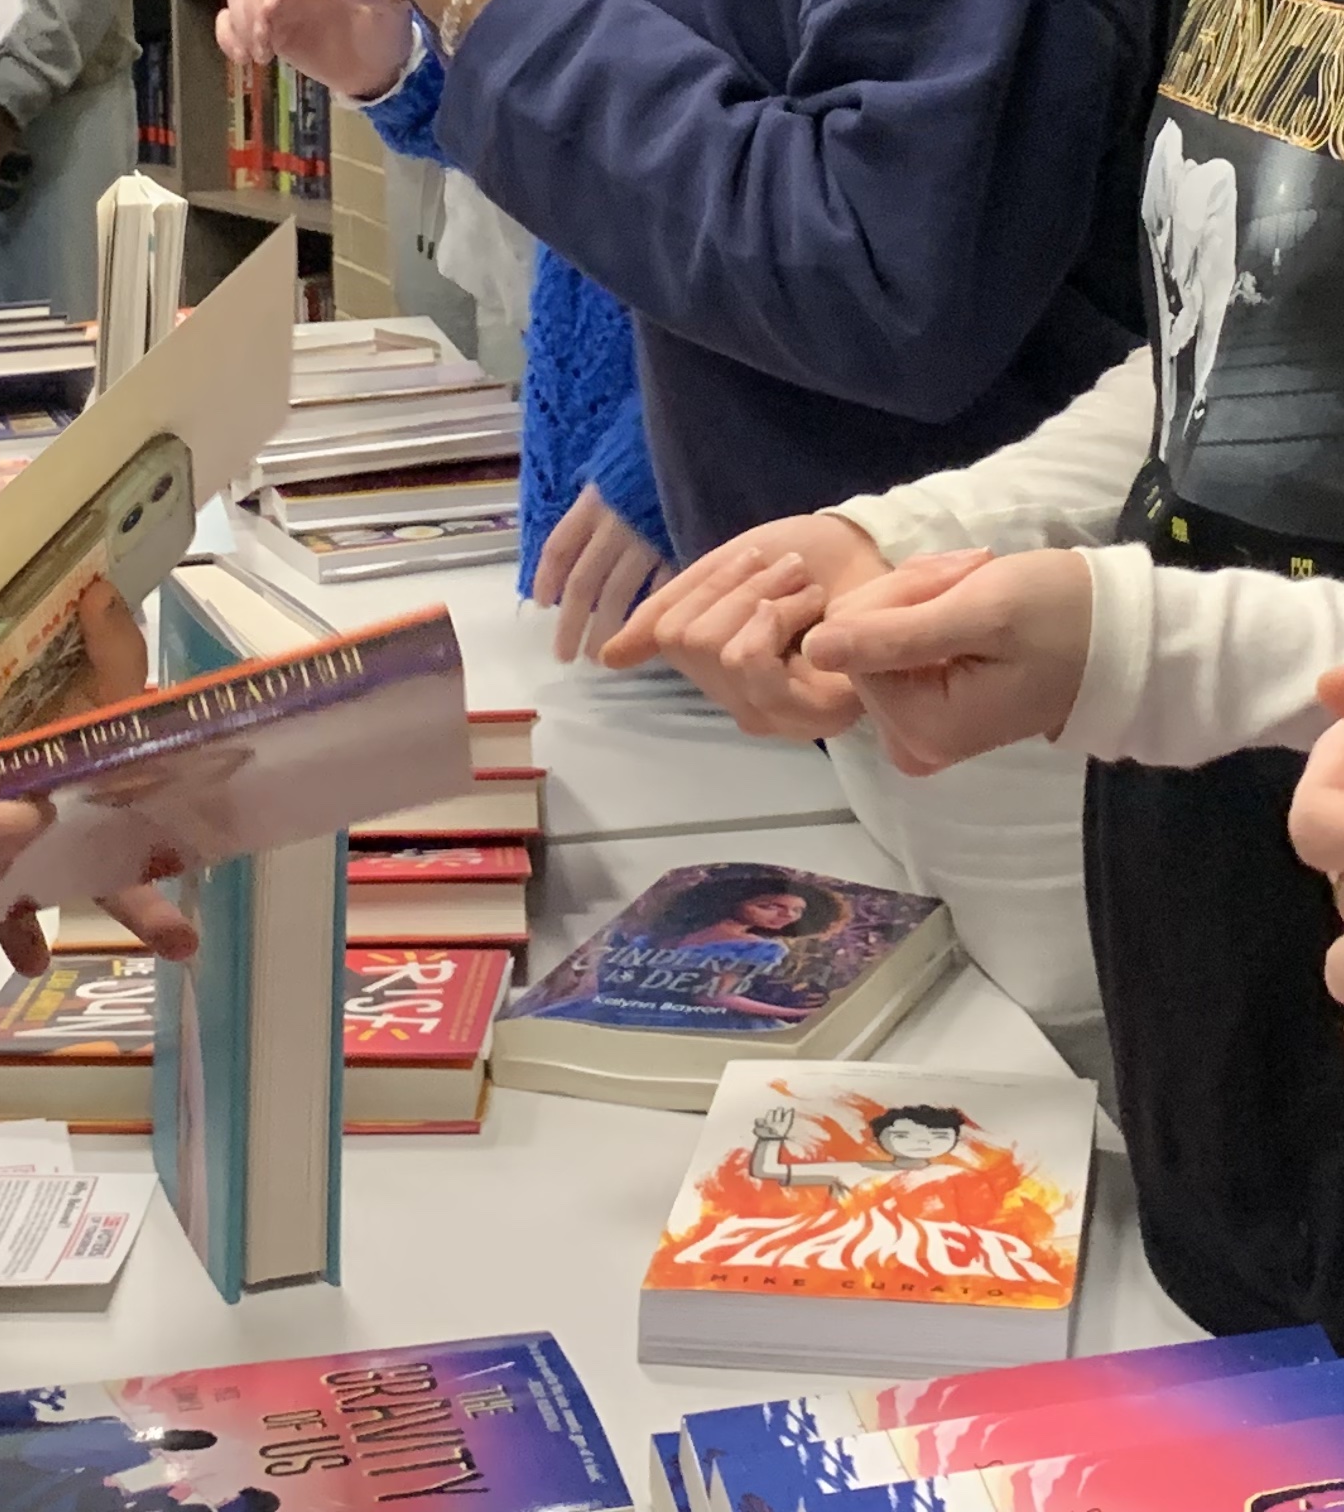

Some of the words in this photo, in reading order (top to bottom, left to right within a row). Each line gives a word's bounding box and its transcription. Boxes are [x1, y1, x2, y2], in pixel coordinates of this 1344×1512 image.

[343, 958, 458, 1035] RISE
[591, 993, 656, 1012] Kalynn
[659, 1000, 728, 1017] Bayron
[673, 1201, 1061, 1286] FLAMER
[709, 1272, 807, 1289] MIKE
[840, 1279, 1006, 1299] CURATO
[261, 1408, 327, 1432] OF
[459, 1384, 518, 1419] THE
[320, 1361, 491, 1503] GRAVITY
[258, 1434, 351, 1477] US
